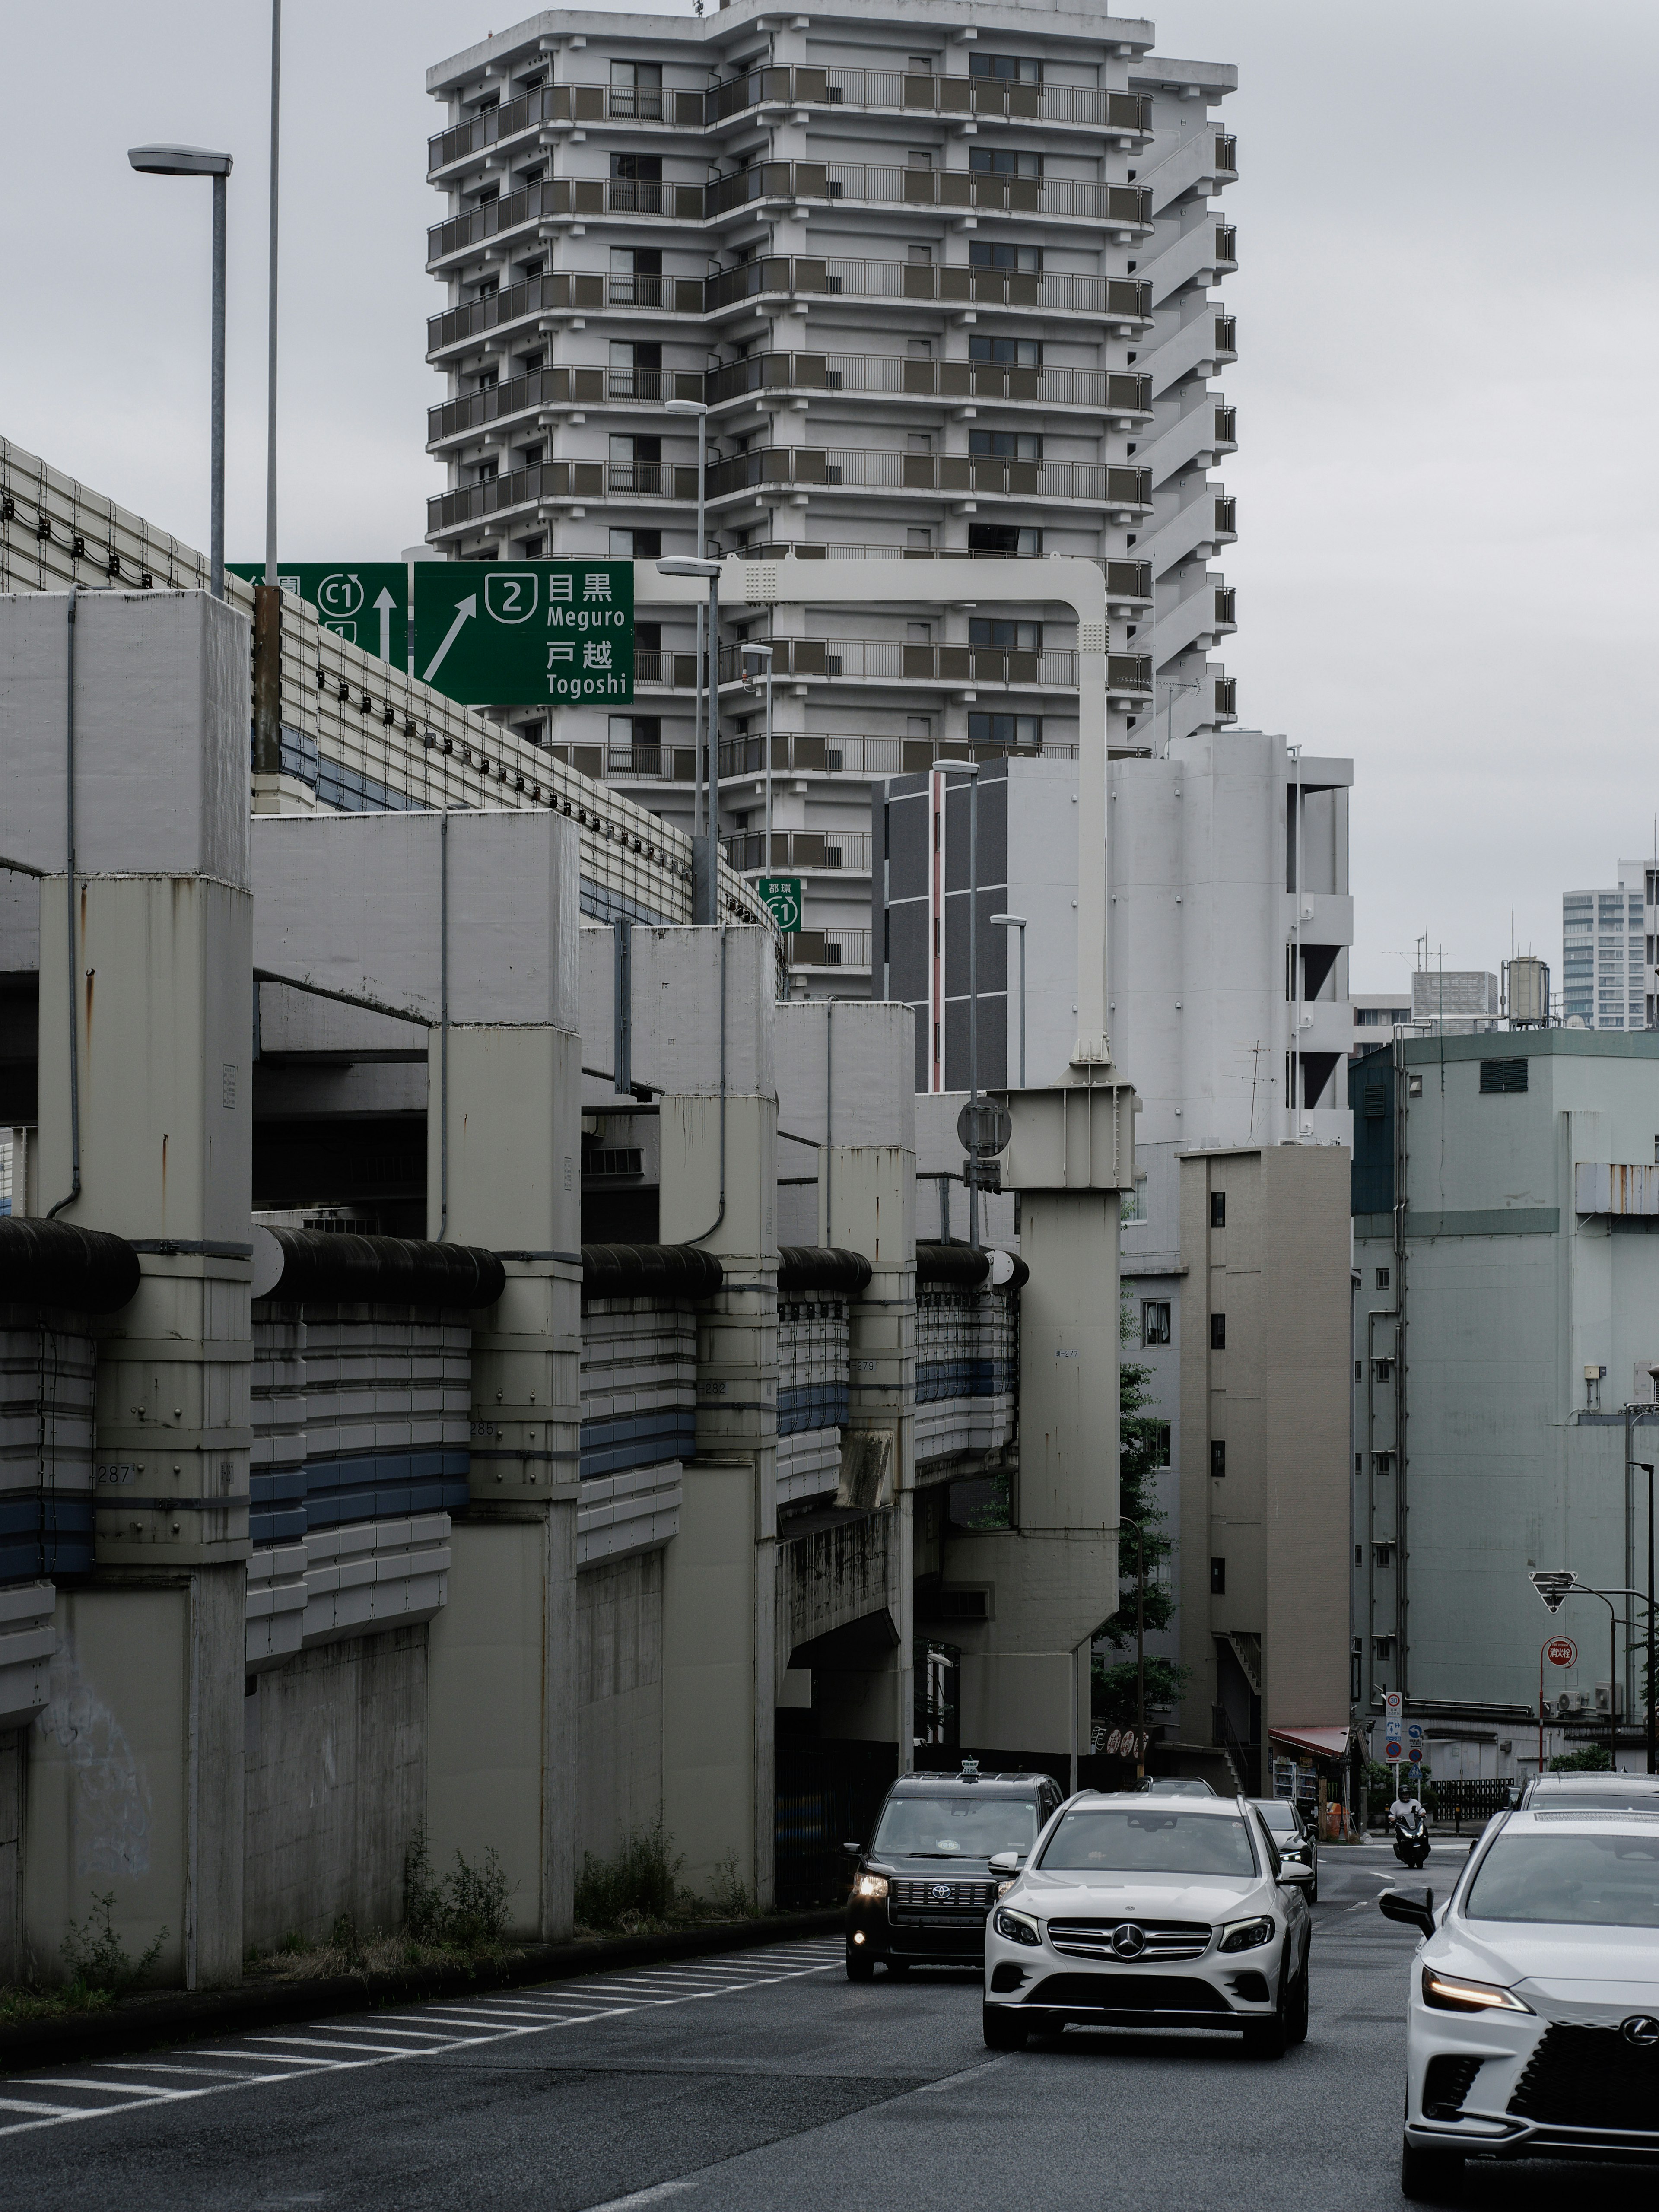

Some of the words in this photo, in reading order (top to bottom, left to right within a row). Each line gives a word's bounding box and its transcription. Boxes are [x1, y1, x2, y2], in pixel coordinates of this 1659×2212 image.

[326, 583, 351, 607] C1
[502, 582, 521, 611] 2
[549, 574, 612, 602] 目黒
[547, 606, 625, 631] Meguro
[546, 640, 612, 669] 戸越
[546, 673, 626, 699] Togoshi
[769, 883, 791, 893] 都環
[98, 1466, 130, 1483] 287
[1550, 1648, 1570, 1658] 消火栓
